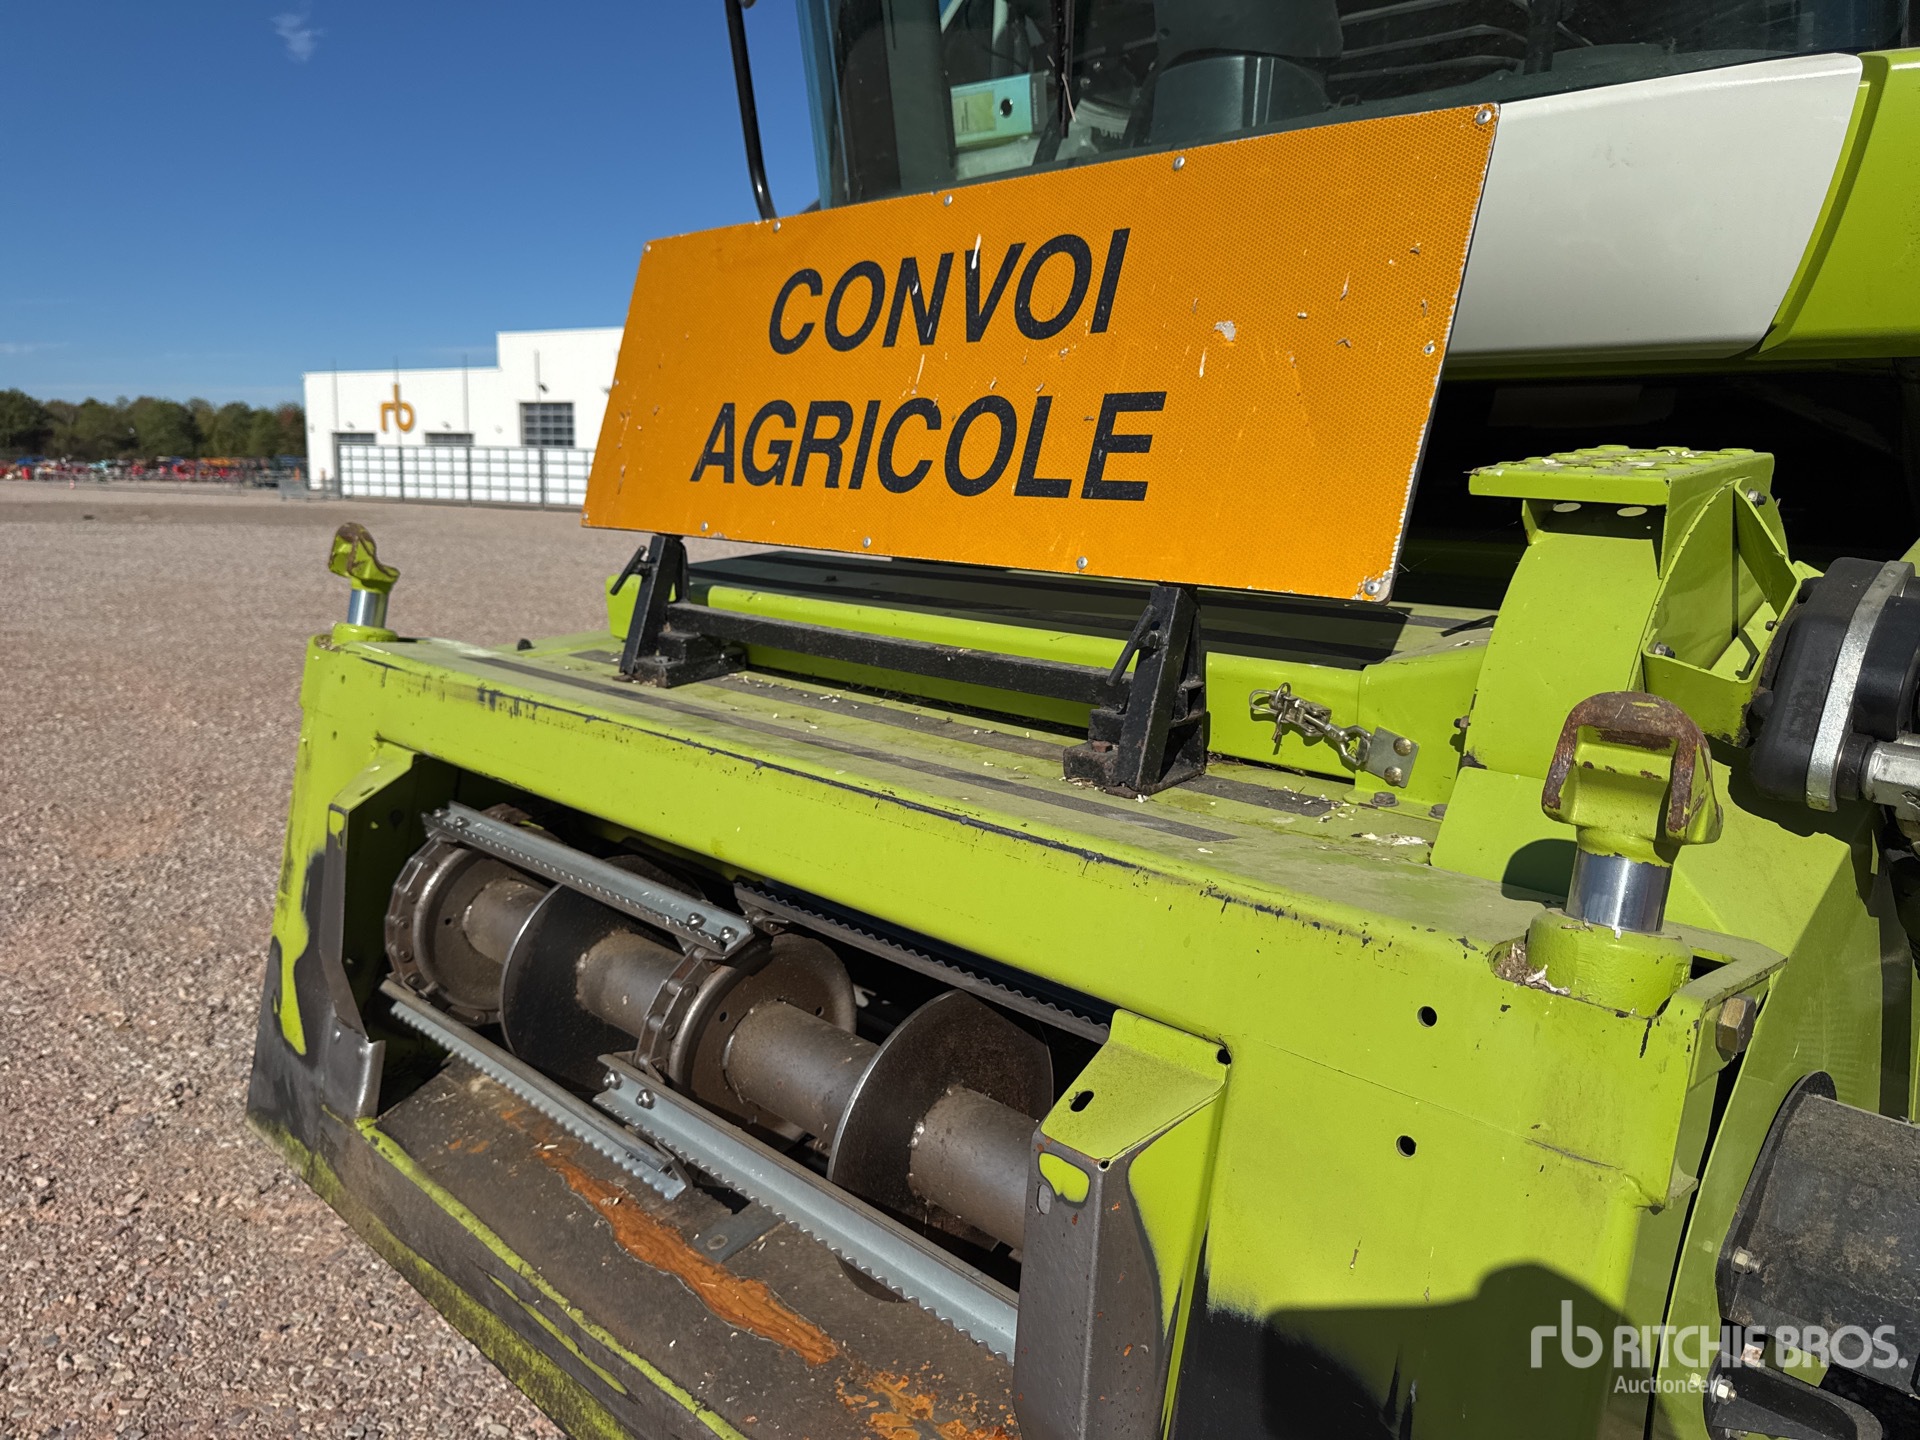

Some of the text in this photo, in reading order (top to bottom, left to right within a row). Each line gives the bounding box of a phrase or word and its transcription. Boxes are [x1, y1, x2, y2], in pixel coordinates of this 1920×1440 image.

[769, 228, 1131, 355] CONVOI
[380, 383, 416, 433] rb
[690, 391, 1168, 502] AGRICOLE
